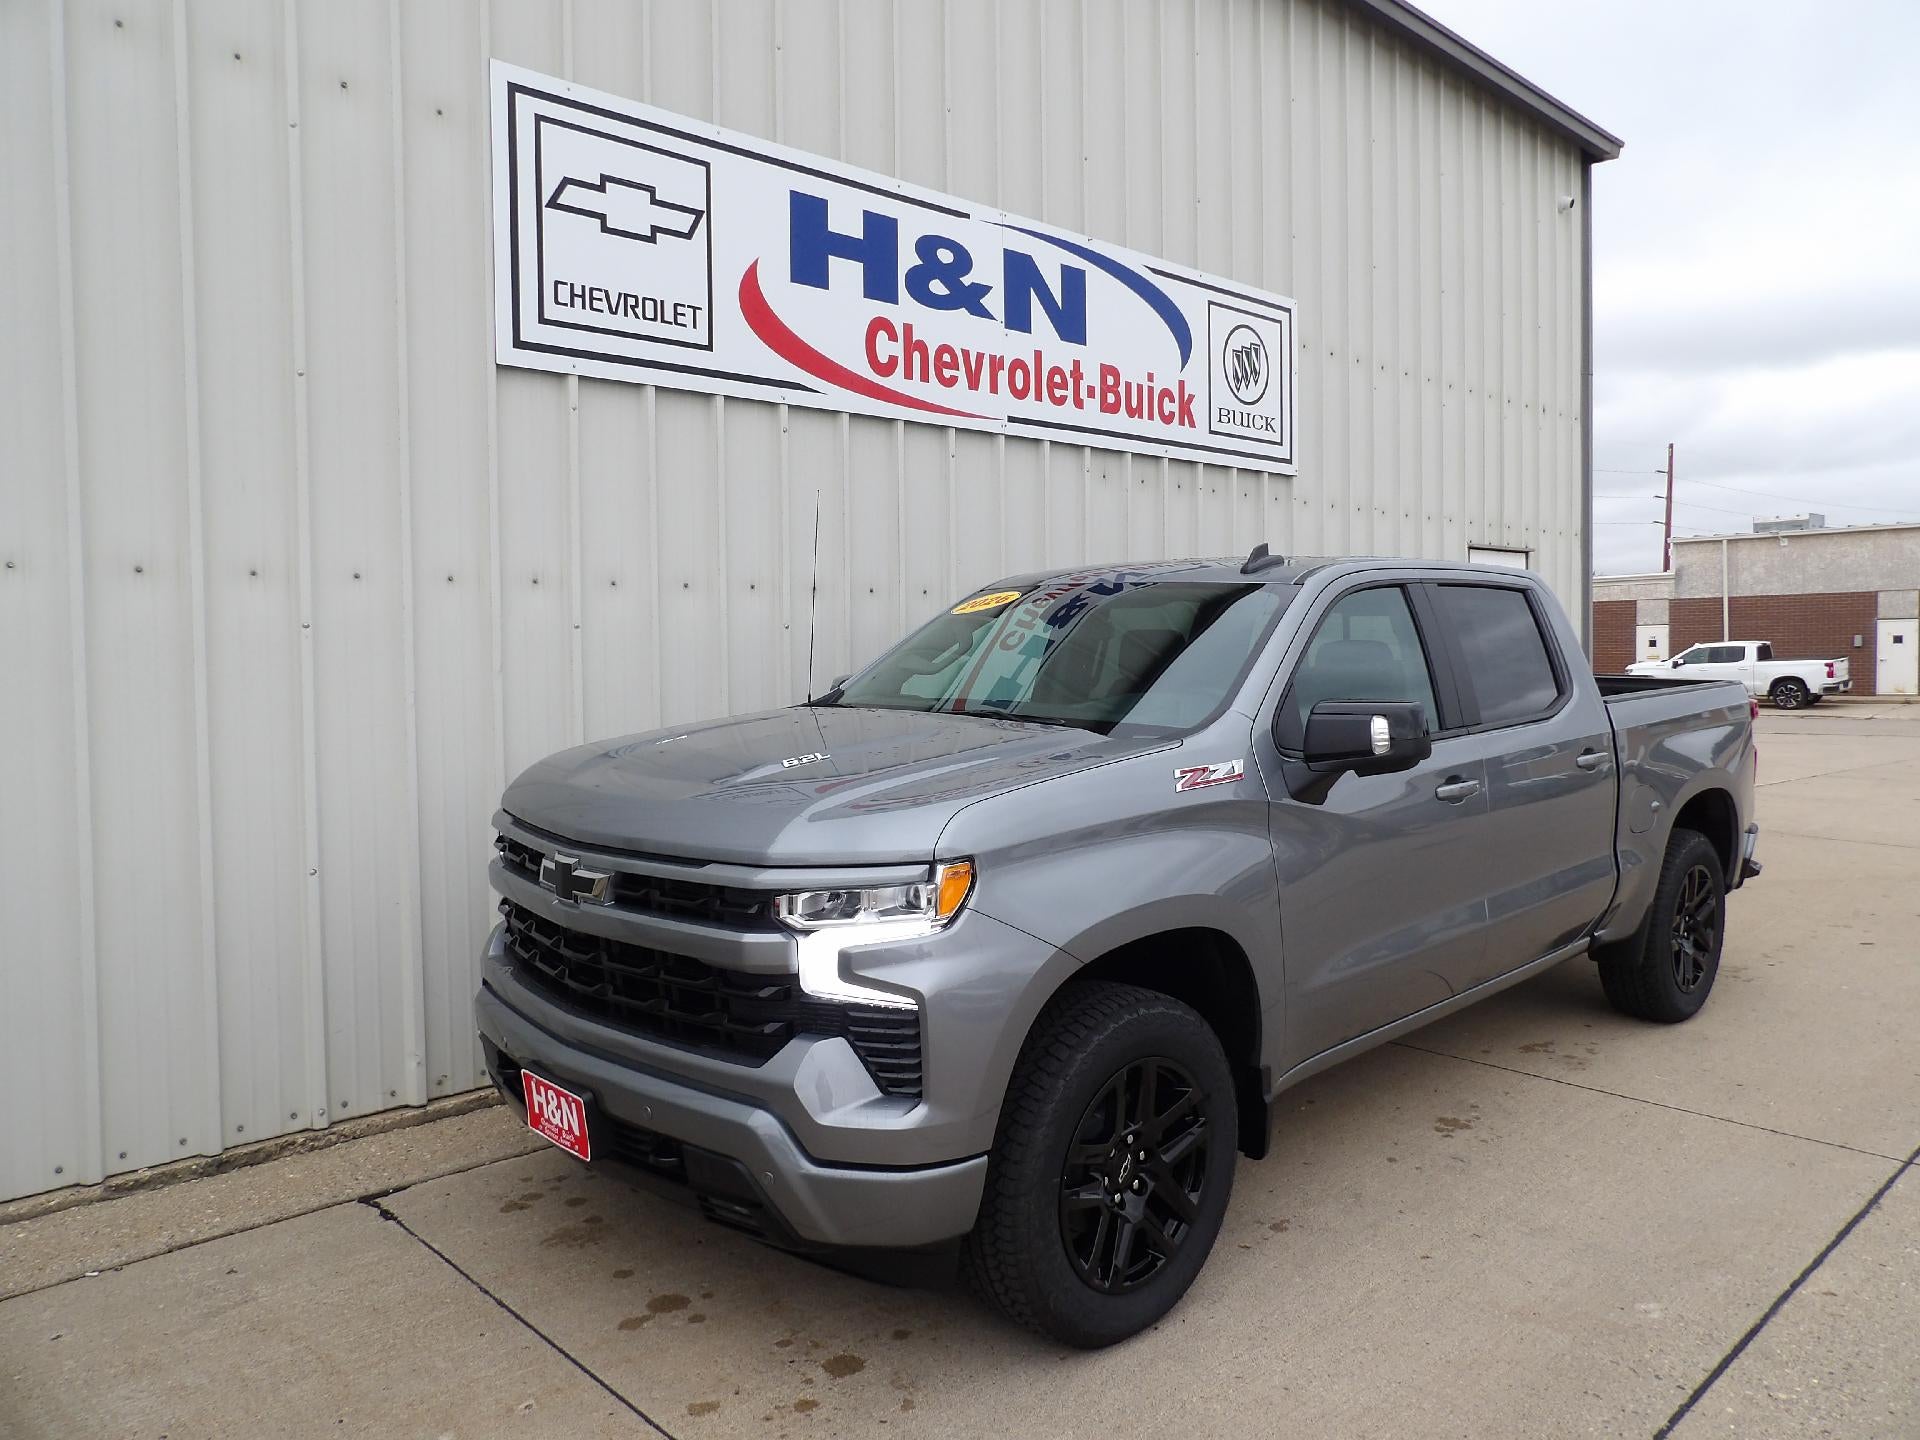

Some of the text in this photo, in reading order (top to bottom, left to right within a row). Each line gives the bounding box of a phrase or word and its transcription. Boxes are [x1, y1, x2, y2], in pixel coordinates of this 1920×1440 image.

[790, 190, 1087, 346] H&N
[553, 279, 702, 330] CHEVROLET
[865, 316, 1197, 429] Chevrolet-Buick
[1217, 407, 1277, 433] BUICK
[1174, 759, 1245, 793] Z71
[530, 1080, 581, 1136] H&N
